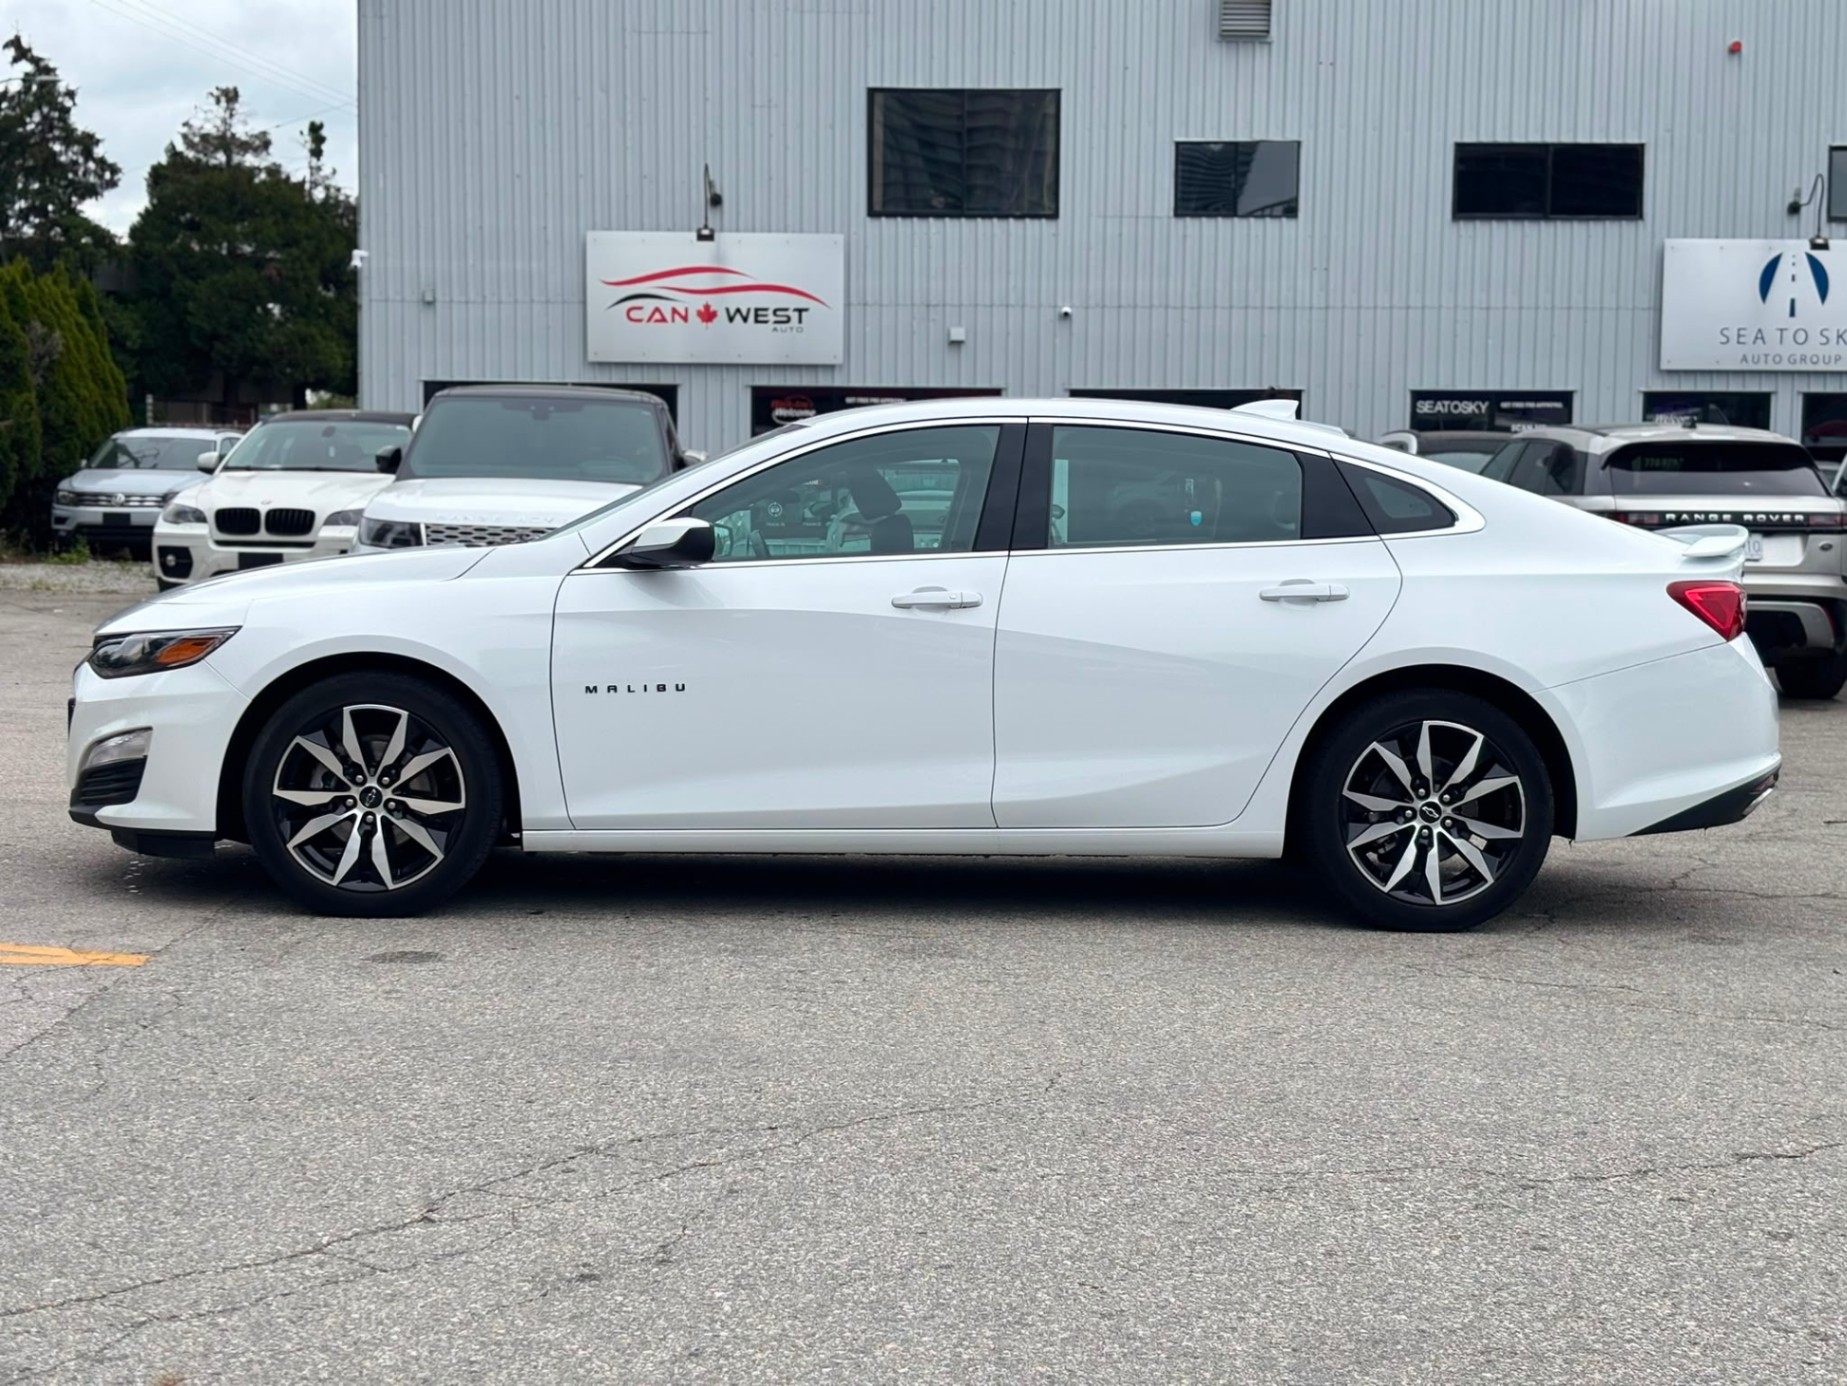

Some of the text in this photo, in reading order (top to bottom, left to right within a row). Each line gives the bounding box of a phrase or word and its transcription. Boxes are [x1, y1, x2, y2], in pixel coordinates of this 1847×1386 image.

[626, 306, 810, 324] CAN WEST
[1719, 327, 1767, 345] SEA
[1775, 328, 1809, 345] TO
[1740, 353, 1842, 366] AUTO GROUP
[1415, 401, 1489, 414] SEATOSKY
[1665, 513, 1732, 521] RANGE
[584, 683, 686, 695] MALIBU
